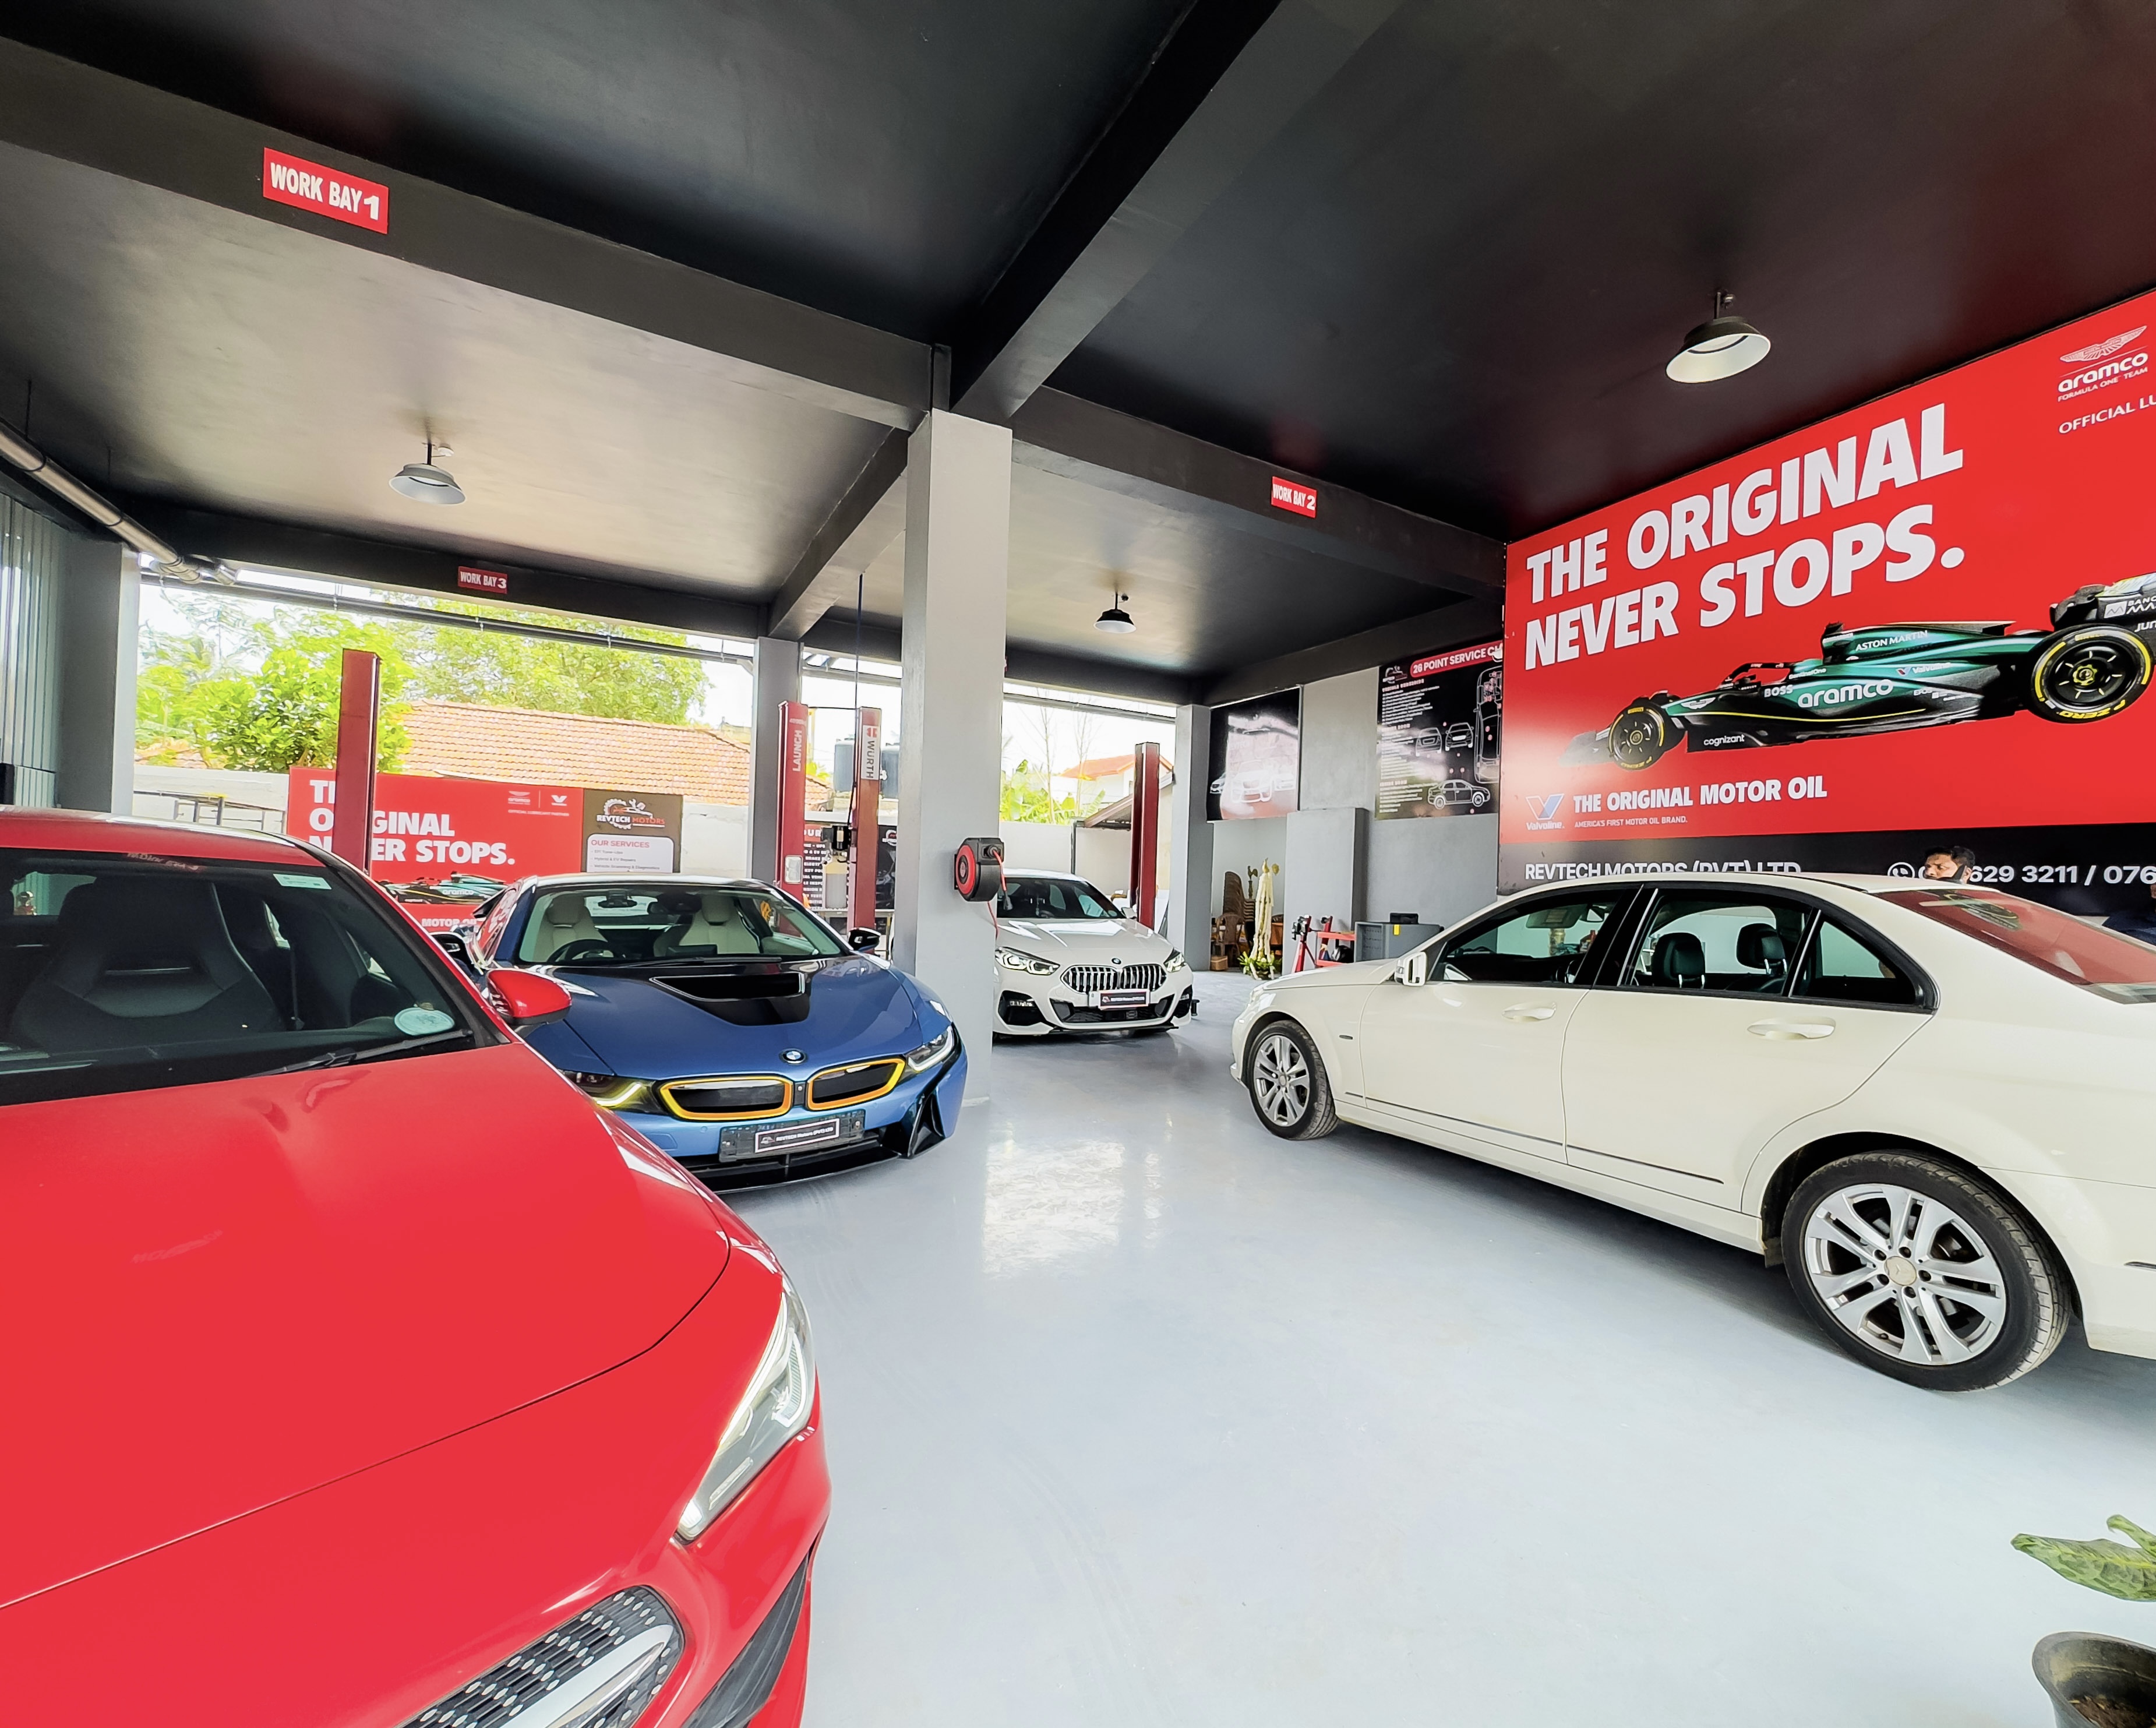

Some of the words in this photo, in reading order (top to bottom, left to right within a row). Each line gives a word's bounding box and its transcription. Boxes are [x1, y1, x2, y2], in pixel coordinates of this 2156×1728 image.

[270, 162, 323, 203] WORK
[329, 181, 362, 213] BAY
[364, 195, 379, 220] 1
[2058, 352, 2148, 392] aramco
[2058, 385, 2098, 402] FORMULA
[2099, 377, 2119, 387] ONE
[2123, 366, 2148, 379] TEAM
[2059, 402, 2136, 434] OFFICIAL
[1272, 484, 1292, 503] WORK
[1293, 490, 1306, 507] BAY
[1307, 495, 1315, 511] 2
[1526, 528, 1608, 604] THE
[1627, 403, 1964, 570] ORIGINAL
[460, 572, 481, 585] WORK
[483, 575, 497, 587] BAY
[497, 578, 507, 589] 3
[1525, 581, 1679, 671] NEVER
[1699, 505, 1965, 628] STOPS.
[1855, 638, 1887, 652] ASTON
[1889, 630, 1928, 645] MARTIN
[1423, 658, 1449, 671] POINT
[1449, 648, 1486, 665] SERVICE
[1764, 685, 1794, 698] BOSS
[1798, 679, 1894, 708] aramco
[2059, 707, 2111, 719] ZERO
[792, 729, 802, 772] LAUNCH
[1704, 733, 1745, 747] cognizant
[1573, 793, 1601, 813] THE
[1607, 787, 1693, 812] ORIGINAL
[1700, 779, 1782, 805] MOTOR
[1787, 775, 1827, 800] OIL
[597, 814, 631, 823] REVTECH
[1526, 821, 1562, 831] Valvoline
[1575, 820, 1605, 828] AMERICA'S
[1625, 817, 1648, 826] MOTOR
[1649, 817, 1660, 825] OIL
[1661, 816, 1688, 824] BRAND.
[415, 839, 516, 865] STOPS.
[1526, 863, 1601, 880] REVTECH
[2021, 865, 2077, 883] 3211
